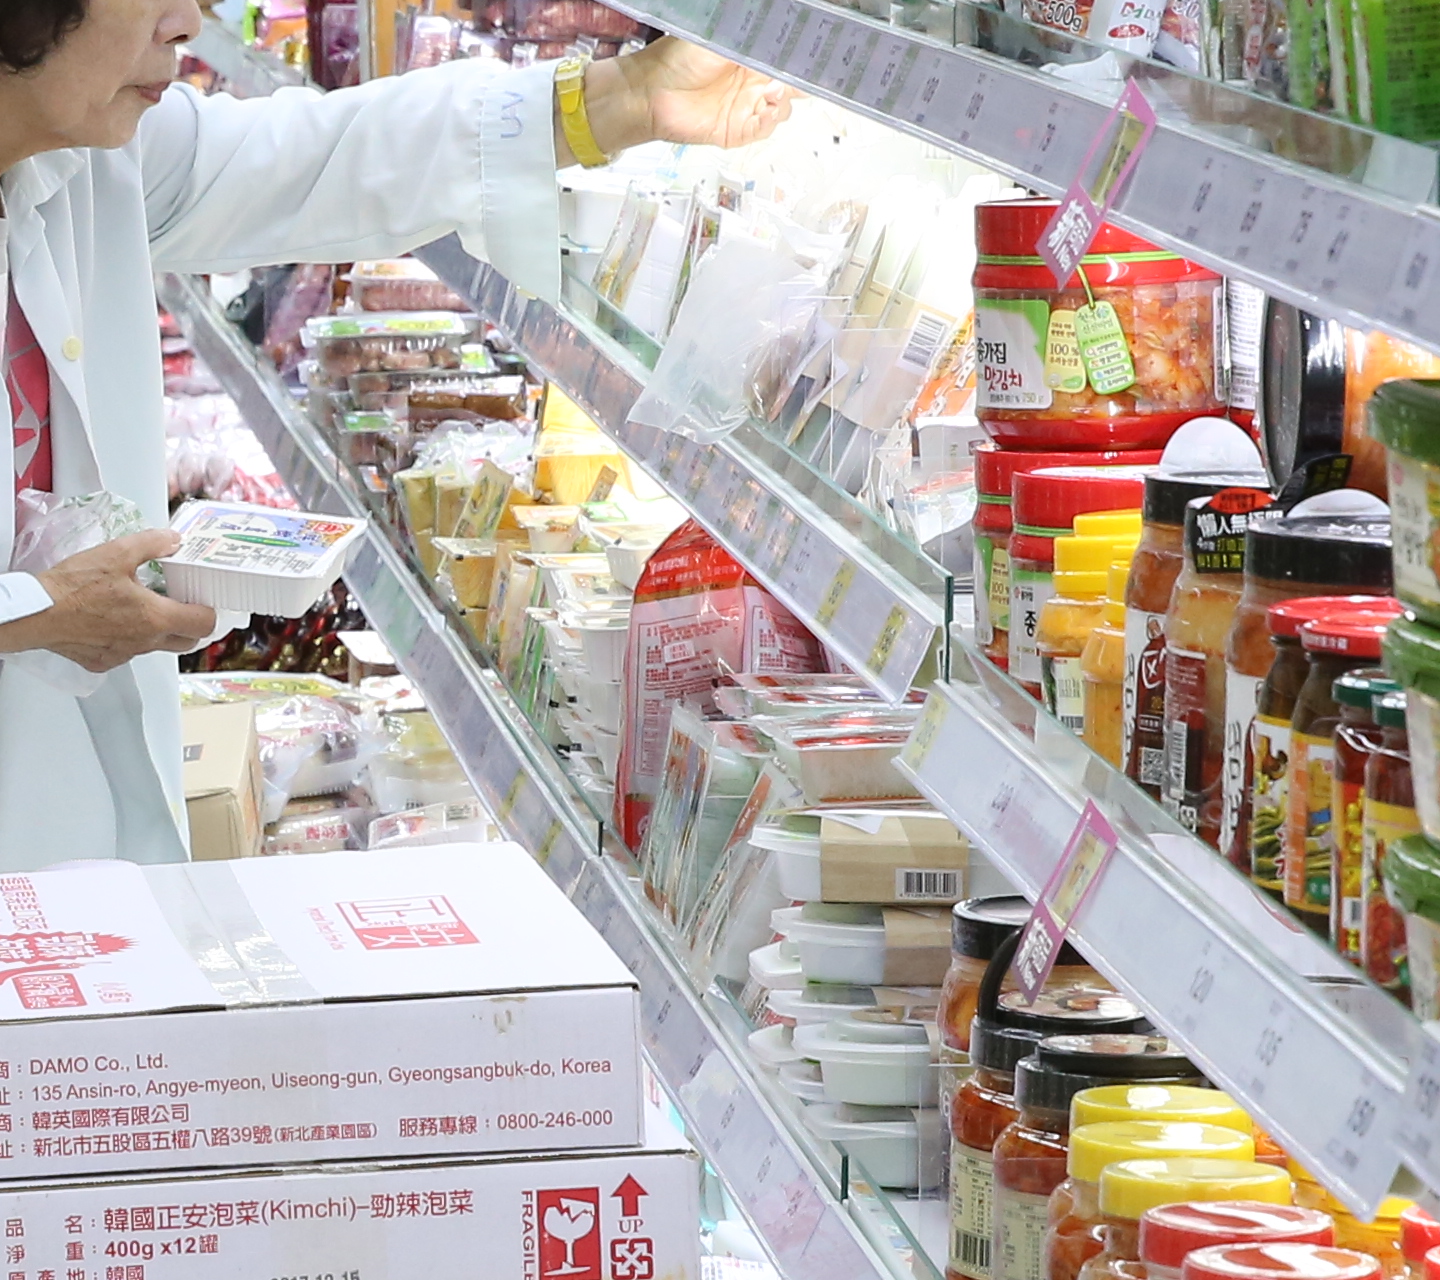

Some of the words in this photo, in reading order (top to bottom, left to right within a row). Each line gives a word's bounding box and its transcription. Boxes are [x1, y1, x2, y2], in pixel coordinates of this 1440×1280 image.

[1047, 0, 1083, 32] 500g
[29, 1057, 90, 1076] DAMO
[94, 1055, 131, 1074] Co.,
[136, 1052, 169, 1070] Ltd.
[32, 1085, 63, 1103] 135
[66, 1080, 142, 1102] Ansin-ro,
[145, 1076, 267, 1100] Angye-myeon,
[271, 1068, 383, 1091] Uiseong-gun,
[388, 1060, 556, 1087] Gyeongsangbuk-do,
[561, 1057, 612, 1076] Korea
[32, 1102, 191, 1132] 韓英國際有限公司
[496, 1109, 613, 1131] 0800-246-000
[619, 1219, 644, 1233] UP
[104, 1238, 154, 1261] 400g
